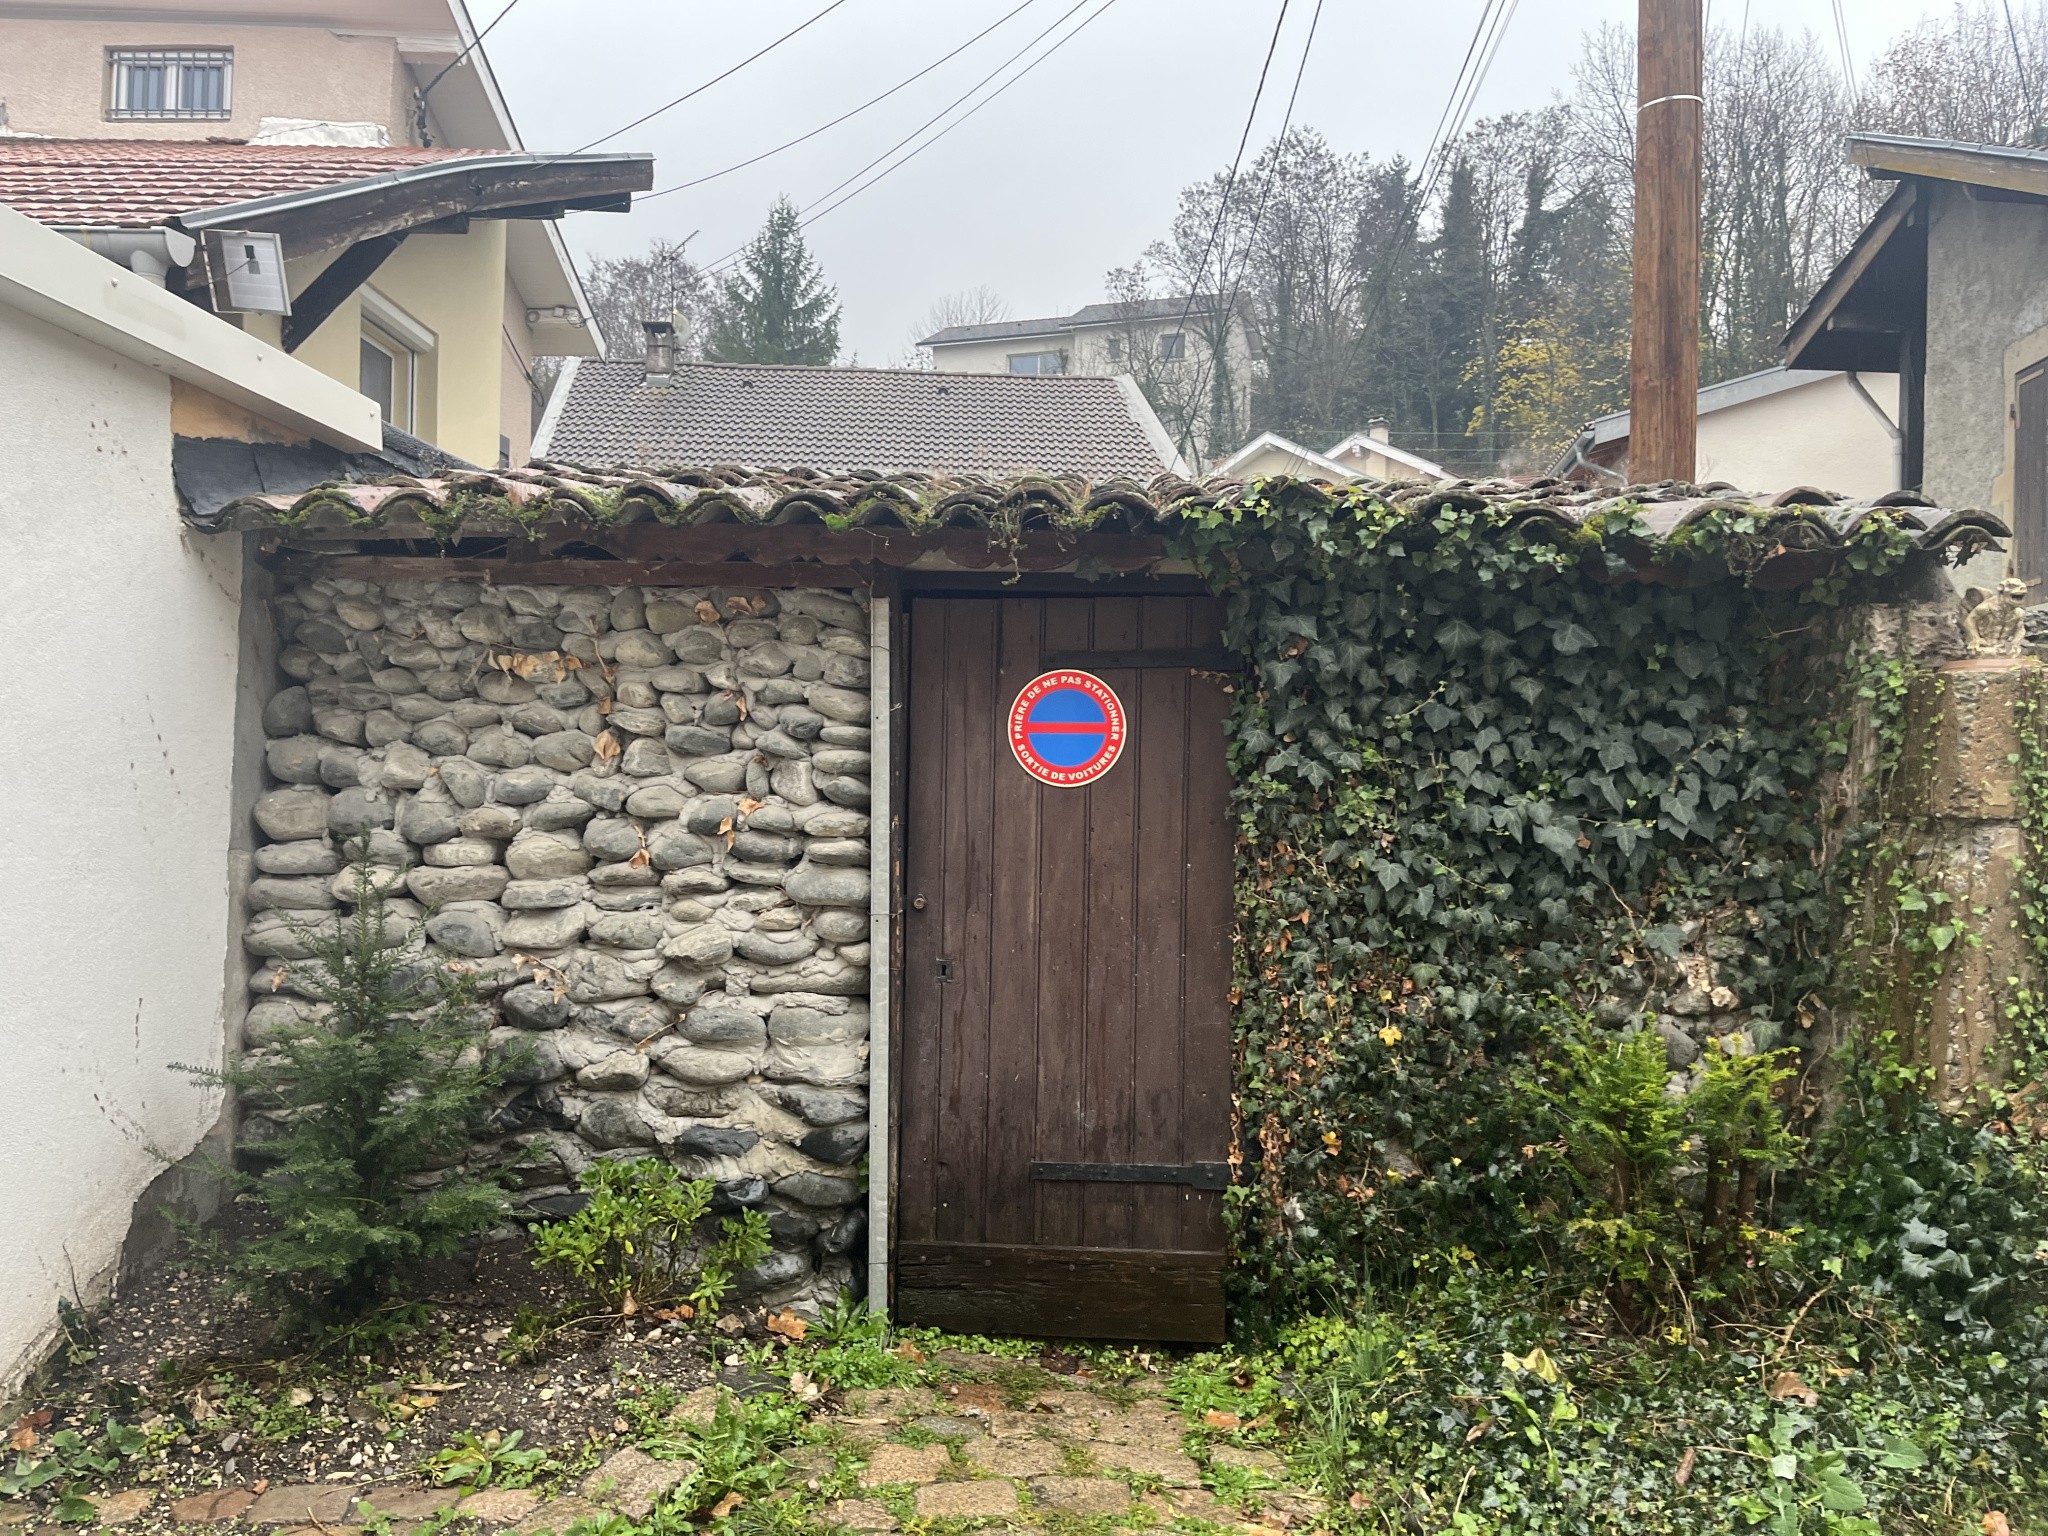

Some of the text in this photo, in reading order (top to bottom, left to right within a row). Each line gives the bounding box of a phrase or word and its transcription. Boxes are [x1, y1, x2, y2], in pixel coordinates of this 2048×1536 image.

[1014, 676, 1119, 740] PRIÈRE DE NE PAS STATIONNER
[1017, 744, 1116, 780] SORTIE DE VOITURES
